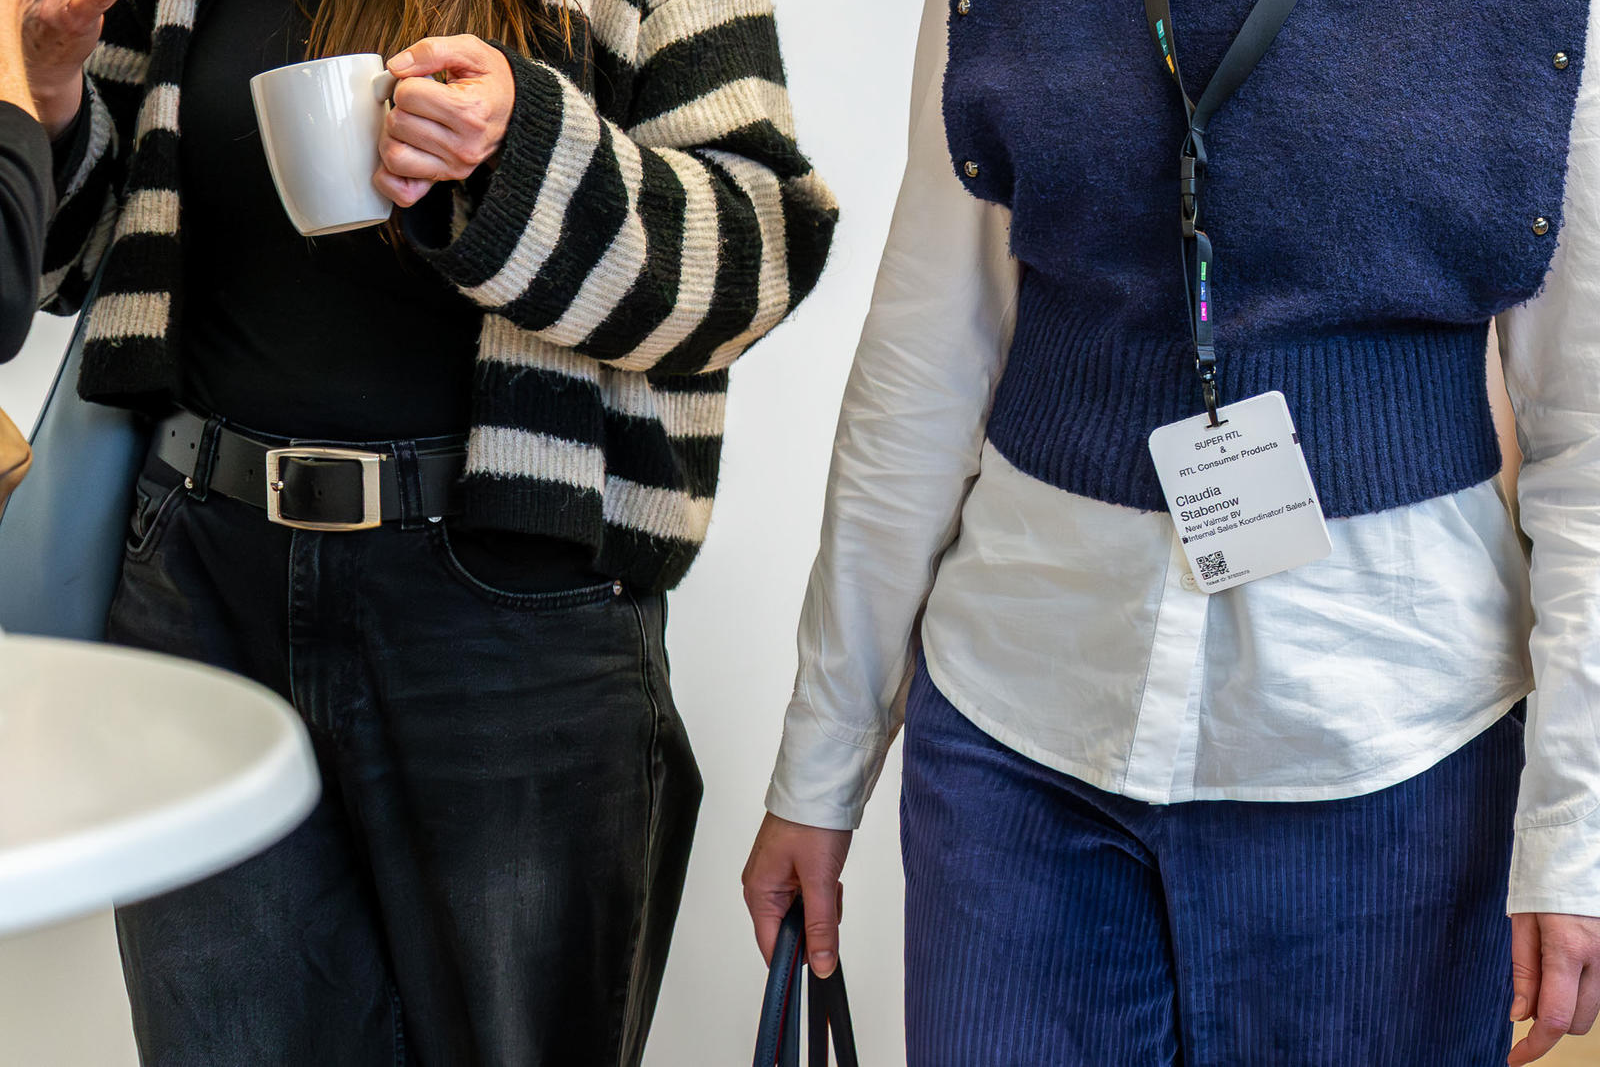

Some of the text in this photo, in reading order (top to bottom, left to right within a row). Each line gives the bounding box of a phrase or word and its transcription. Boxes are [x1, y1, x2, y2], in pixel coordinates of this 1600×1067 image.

[1194, 430, 1242, 451] SUPER RTL
[1219, 445, 1227, 454] &
[1179, 440, 1278, 478] RTL Consumer Products
[1175, 485, 1222, 507] Claudia
[1180, 496, 1239, 522] Stabenow
[1185, 509, 1242, 533] New Valmar BV
[1188, 528, 1217, 543] Internal
[1217, 520, 1239, 533] Sales
[1239, 506, 1284, 526] Koordinator/
[1285, 500, 1307, 512] Sales
